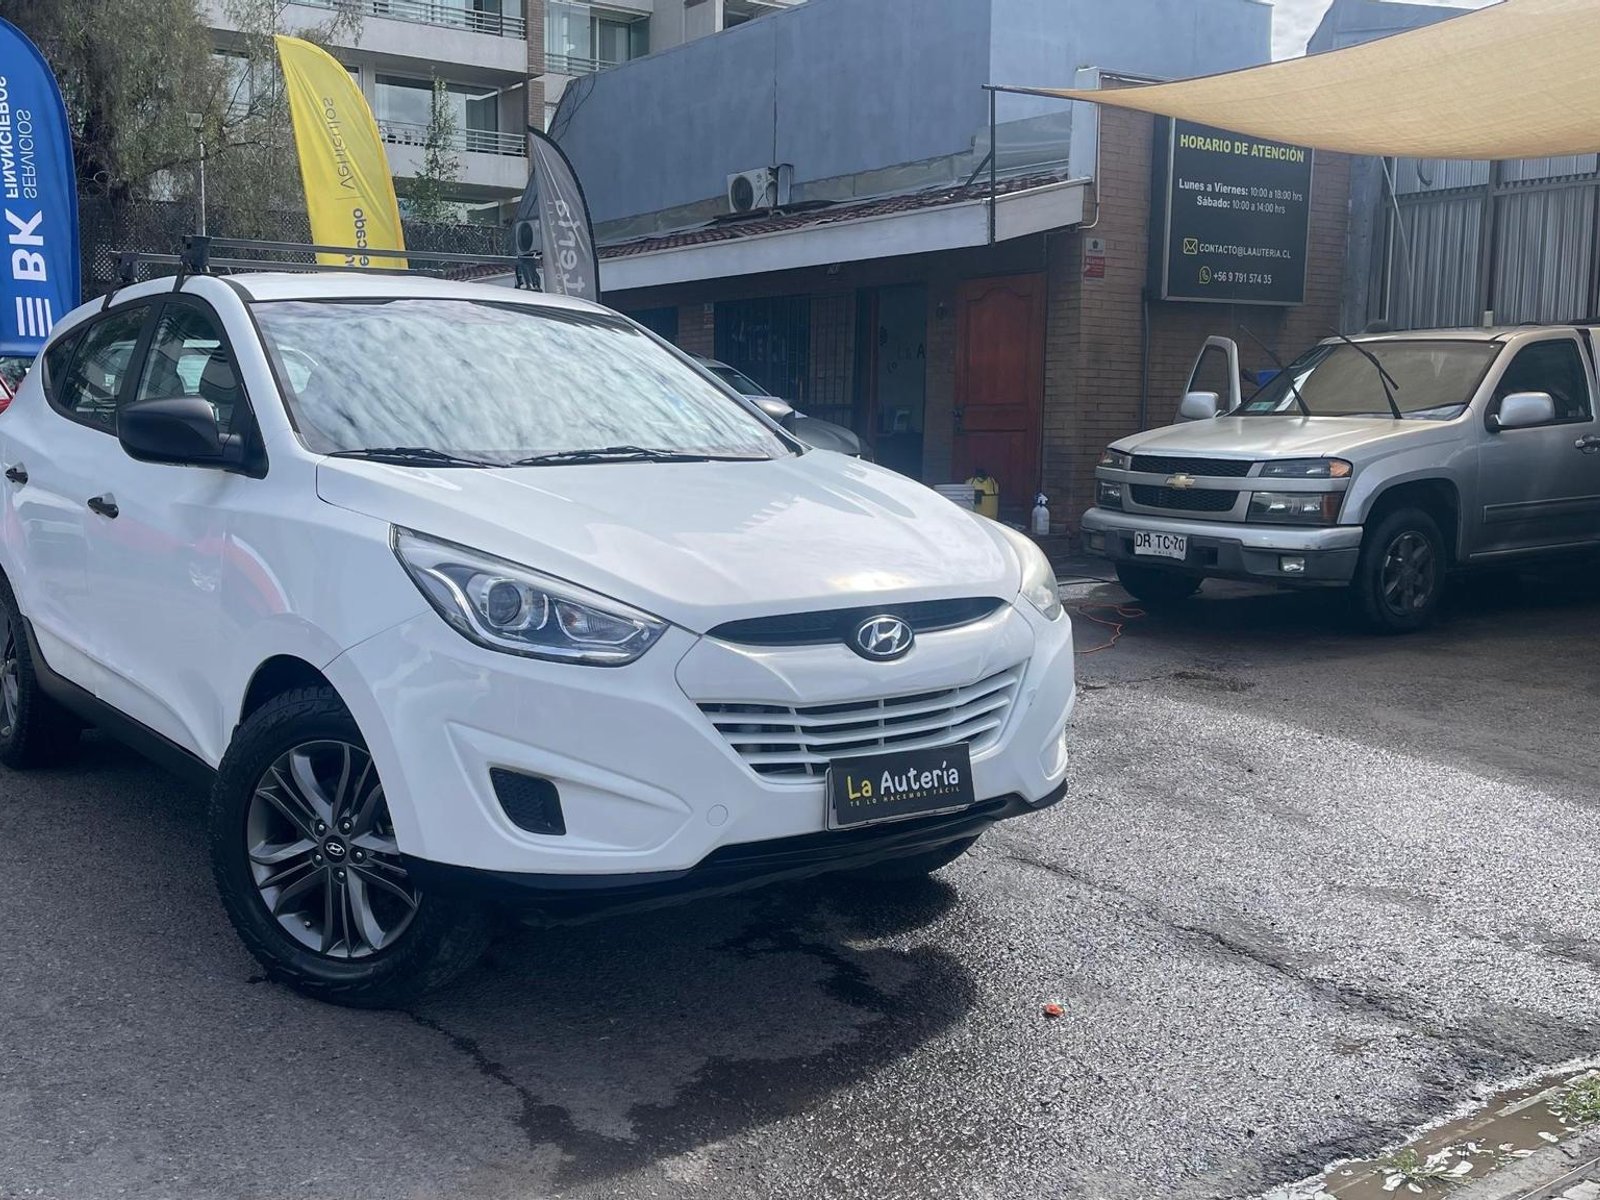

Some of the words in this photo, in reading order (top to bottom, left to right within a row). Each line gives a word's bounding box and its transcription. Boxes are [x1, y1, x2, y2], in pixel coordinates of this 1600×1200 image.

[1180, 134, 1231, 153] HORARIO
[1234, 141, 1248, 156] DE
[1251, 143, 1304, 163] ATENCIÓN
[1179, 178, 1204, 191] Lunes
[1206, 183, 1212, 192] a
[1214, 182, 1248, 196] Viernes:
[1250, 187, 1267, 198] 10:00
[1268, 190, 1273, 199] a
[1292, 191, 1303, 202] hrs
[1197, 195, 1230, 209] Sábado:
[1232, 199, 1250, 210] 10:00
[1250, 203, 1255, 211] a
[1256, 202, 1274, 213] 14:00
[1274, 203, 1286, 214] hrs
[1213, 271, 1227, 282] +56
[1227, 272, 1233, 282] 9
[1235, 272, 1247, 283] 791
[1249, 273, 1262, 284] 574
[1263, 274, 1272, 284] 35
[847, 776, 872, 800] La
[880, 760, 959, 795] Autería
